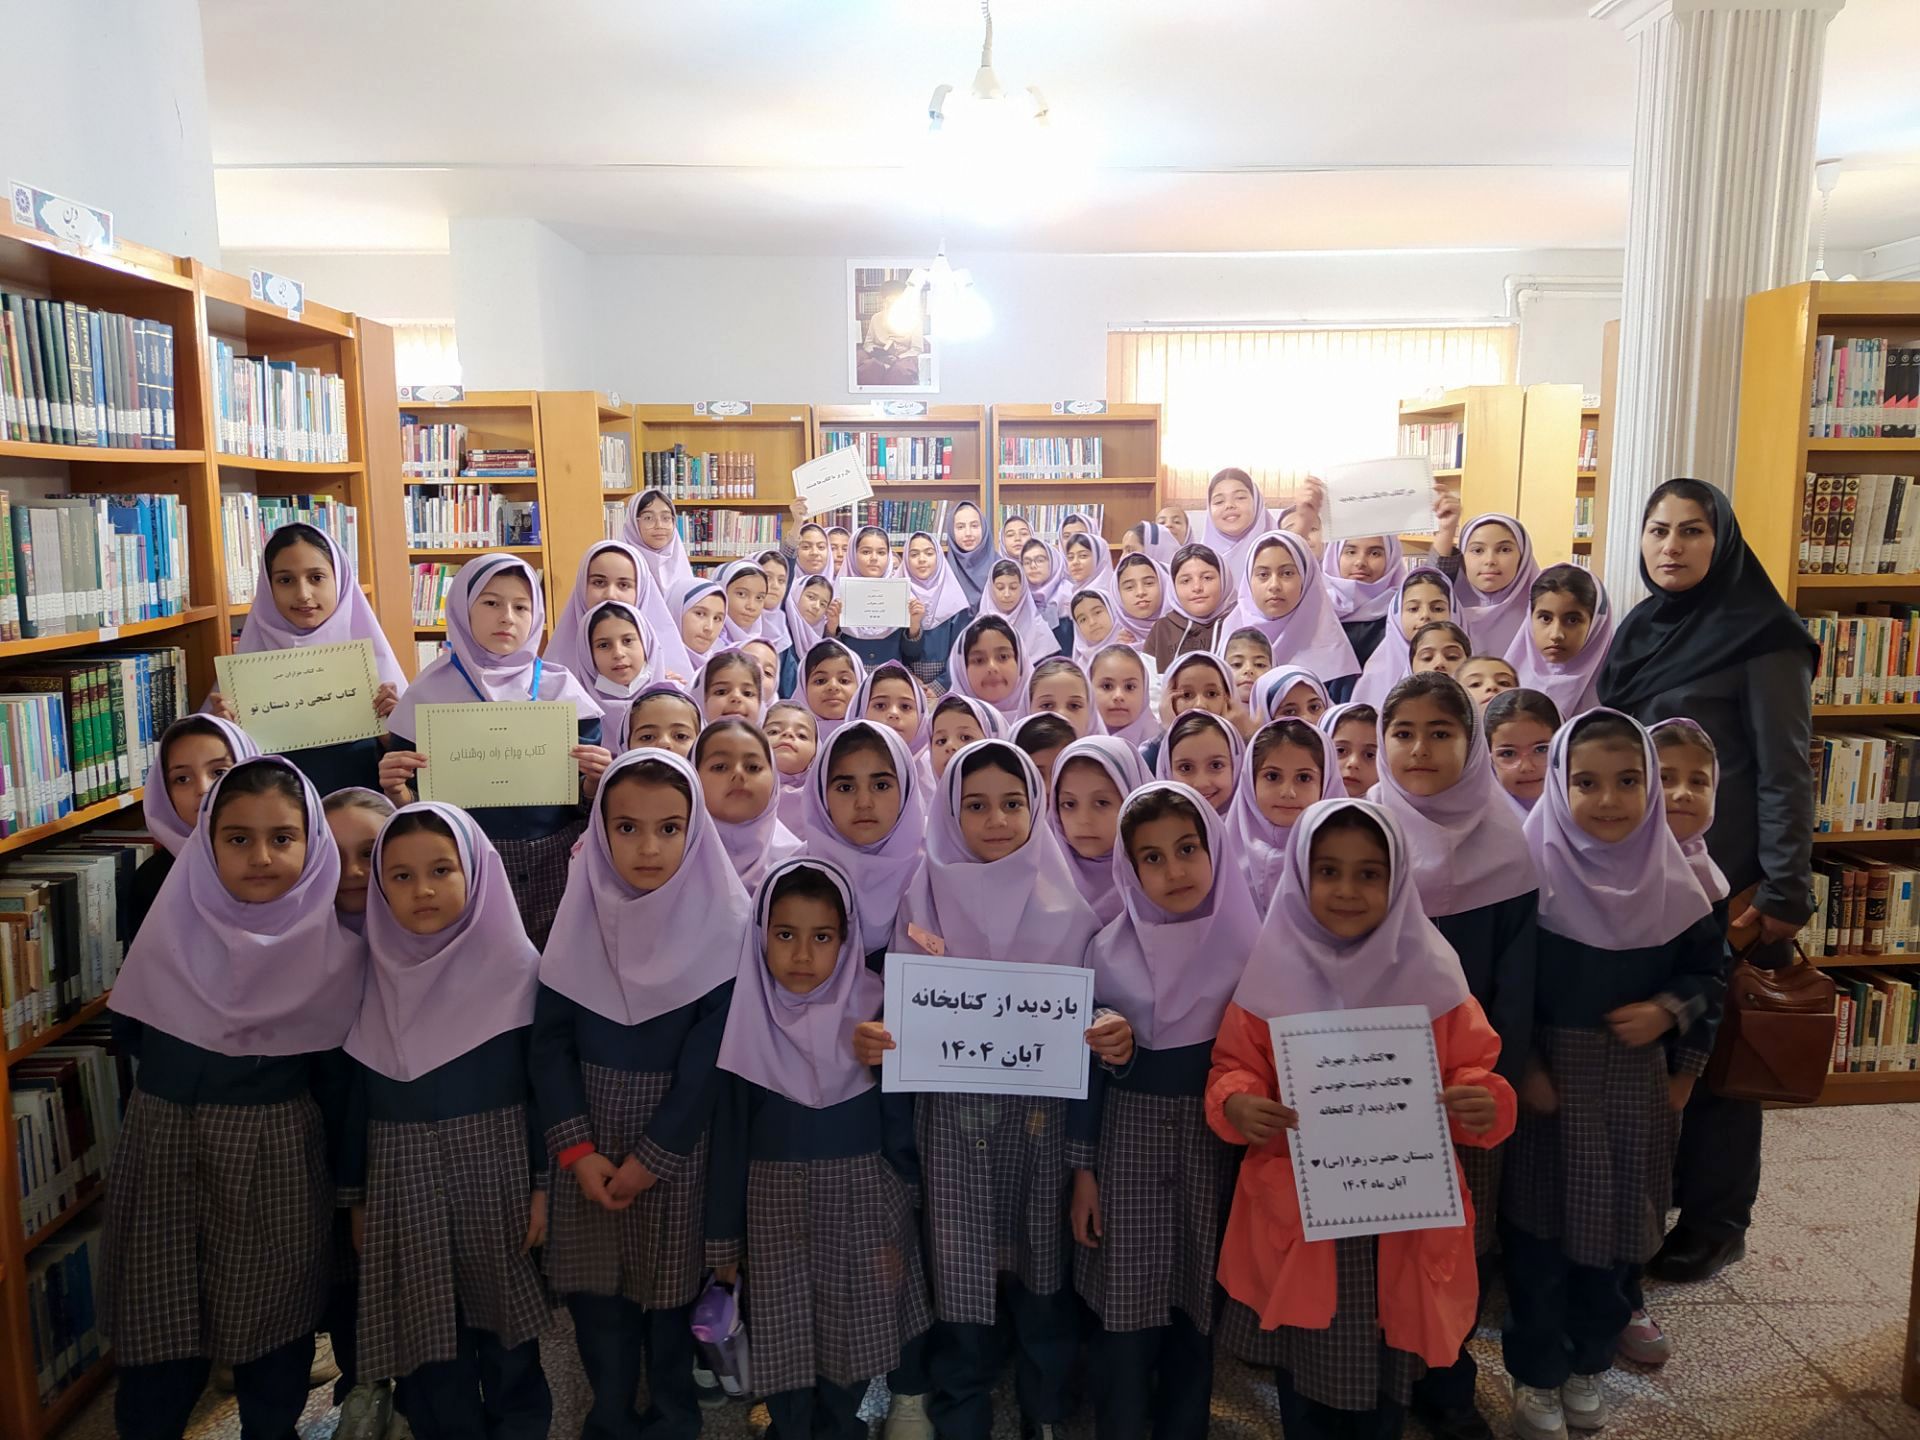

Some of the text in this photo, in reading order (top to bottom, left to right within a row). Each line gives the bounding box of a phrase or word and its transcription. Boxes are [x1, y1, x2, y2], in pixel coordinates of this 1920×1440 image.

[336, 688, 357, 701] کتاب
[251, 703, 259, 716] تو
[262, 700, 290, 714] دستان
[294, 698, 304, 709] در
[450, 743, 547, 763] کتاب چراغ راه روشنایی
[911, 988, 1078, 1021] بازدید از کتابخانه
[941, 1040, 1045, 1068] آبان ۱۴۰۴
[1316, 1052, 1384, 1068] کتاب یار مهربان
[1310, 1077, 1400, 1095] کتاب دوست خوب من
[1320, 1101, 1397, 1116] بازدید از کتابخانه
[1323, 1151, 1434, 1169] دبستان حضرت زهرا (س)
[1342, 1175, 1407, 1192] آبان ماه ۱۴۰۴
